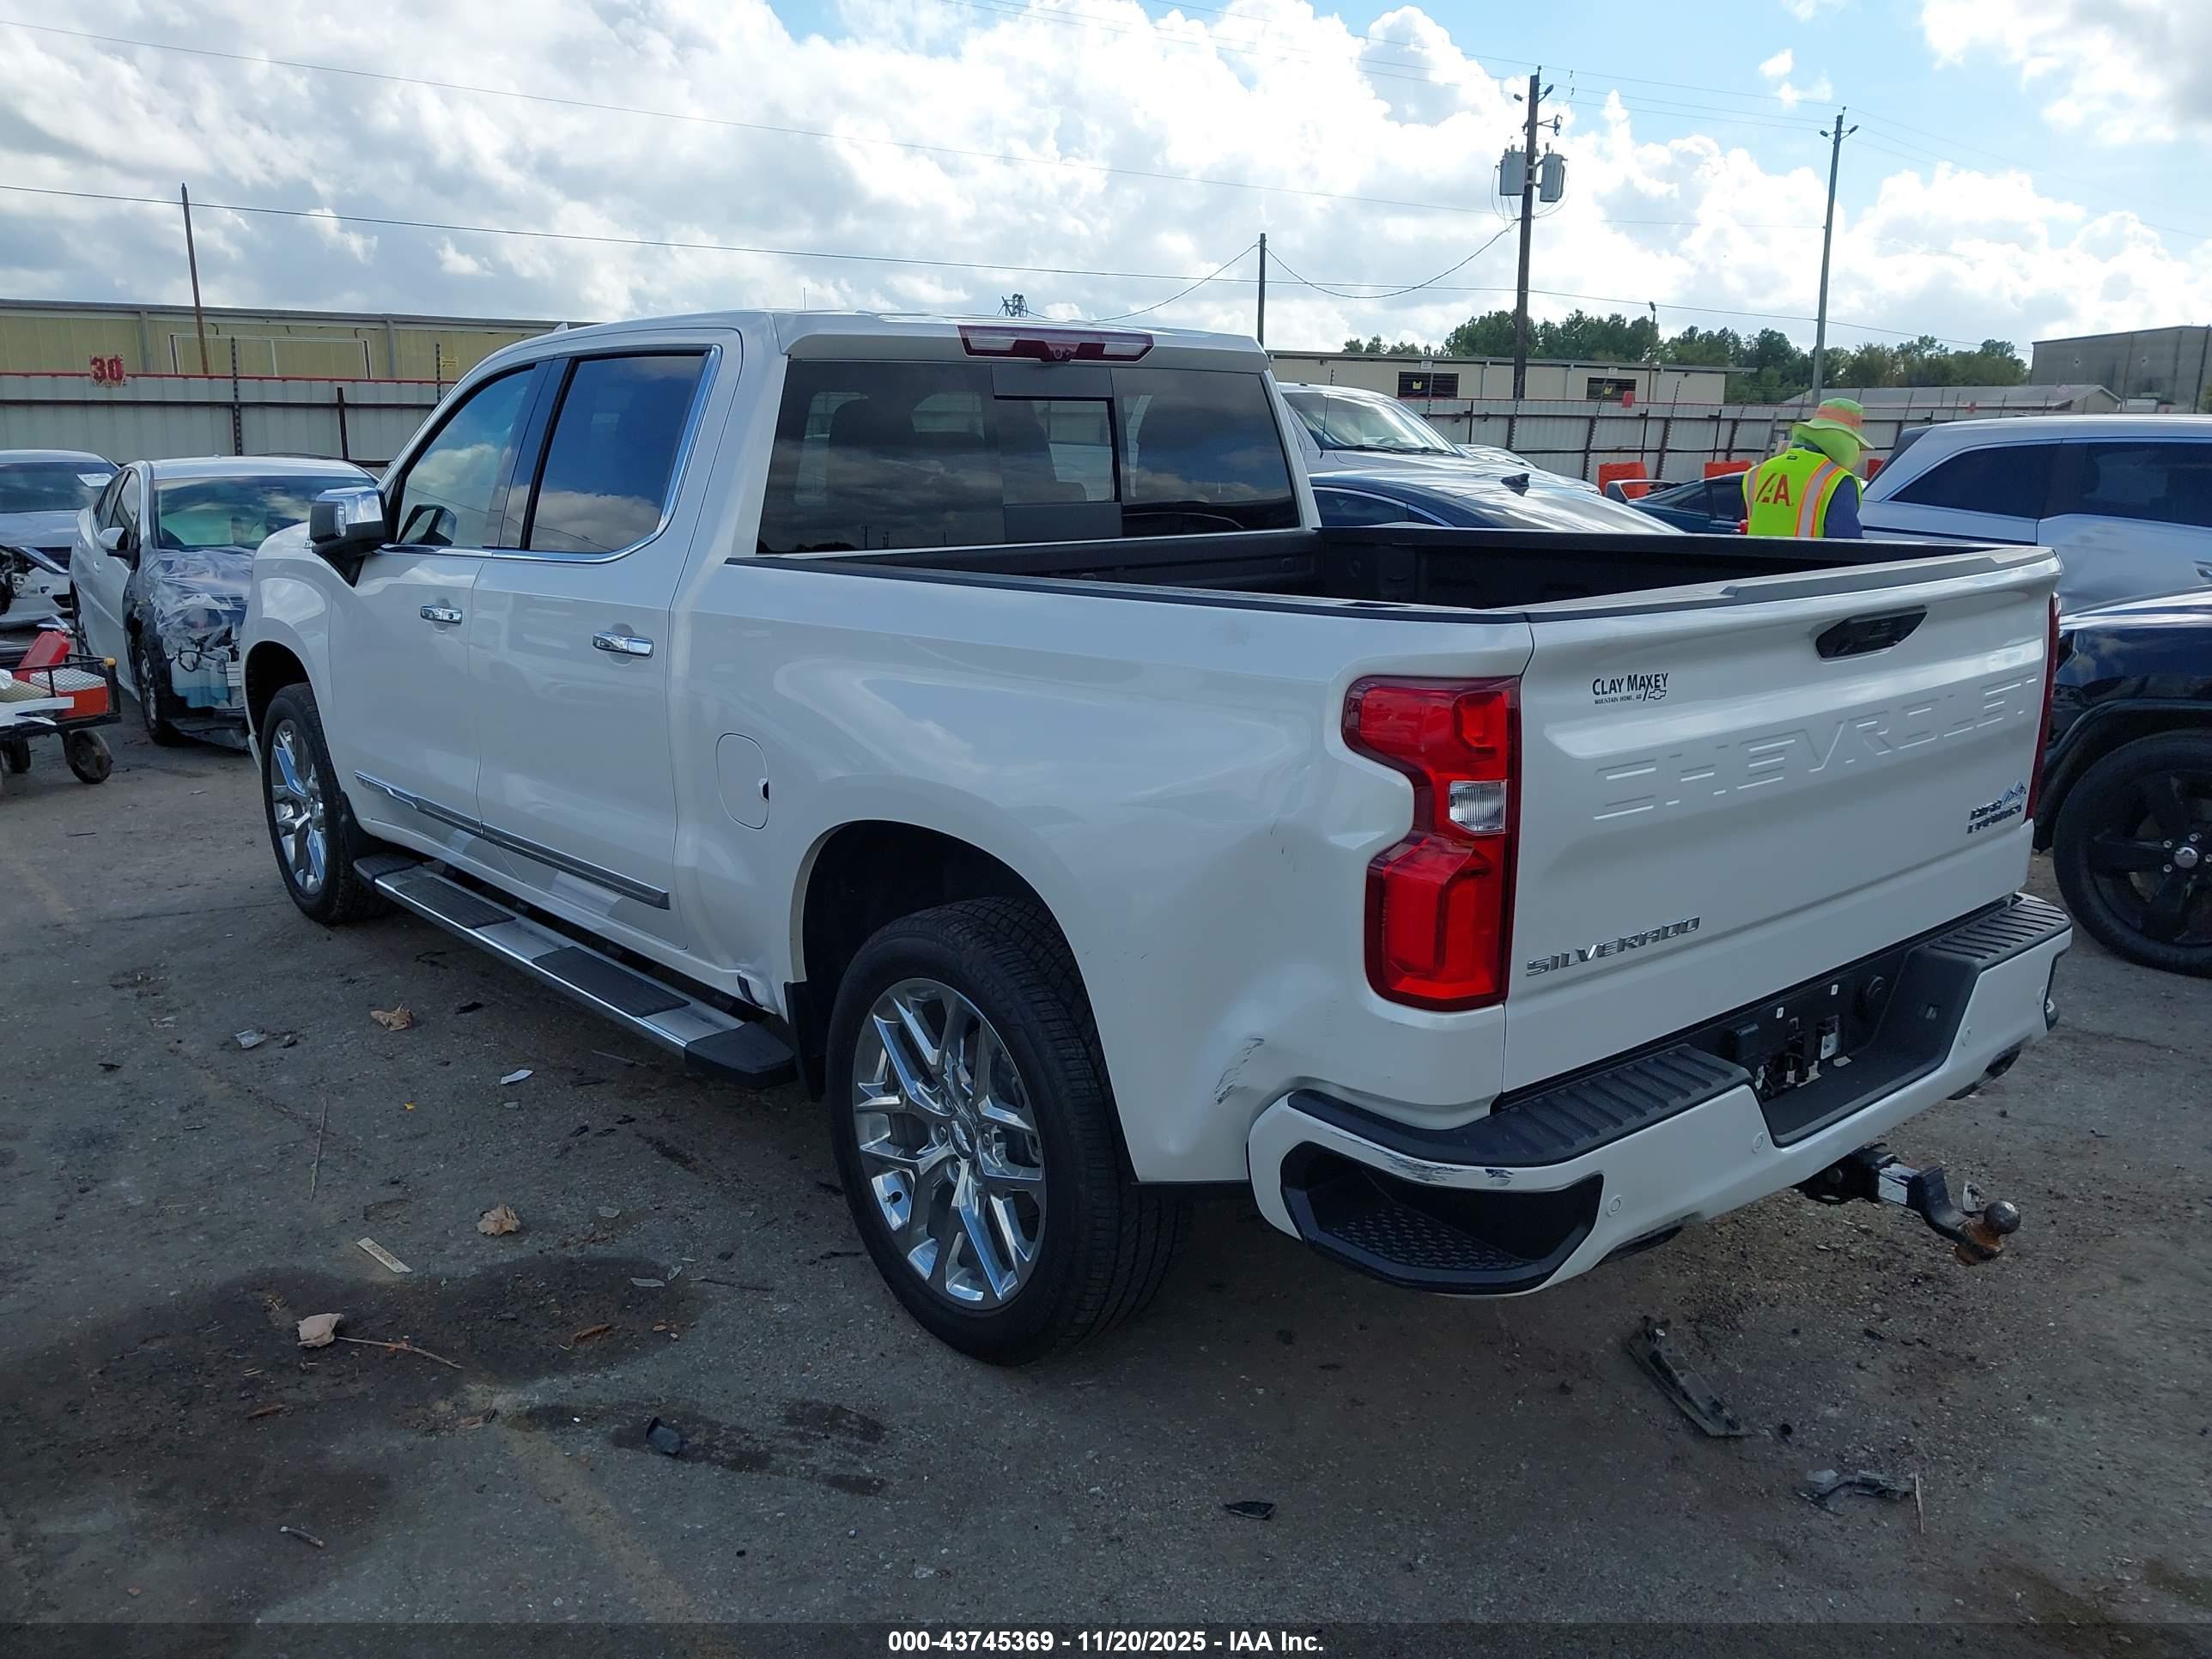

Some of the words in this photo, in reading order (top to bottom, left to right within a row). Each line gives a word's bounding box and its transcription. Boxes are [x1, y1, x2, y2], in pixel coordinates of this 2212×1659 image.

[90, 356, 124, 380] 30
[1592, 678, 1625, 696] CLAY
[1626, 672, 1668, 701] MAXEY
[1526, 915, 1700, 977] SILVERADO
